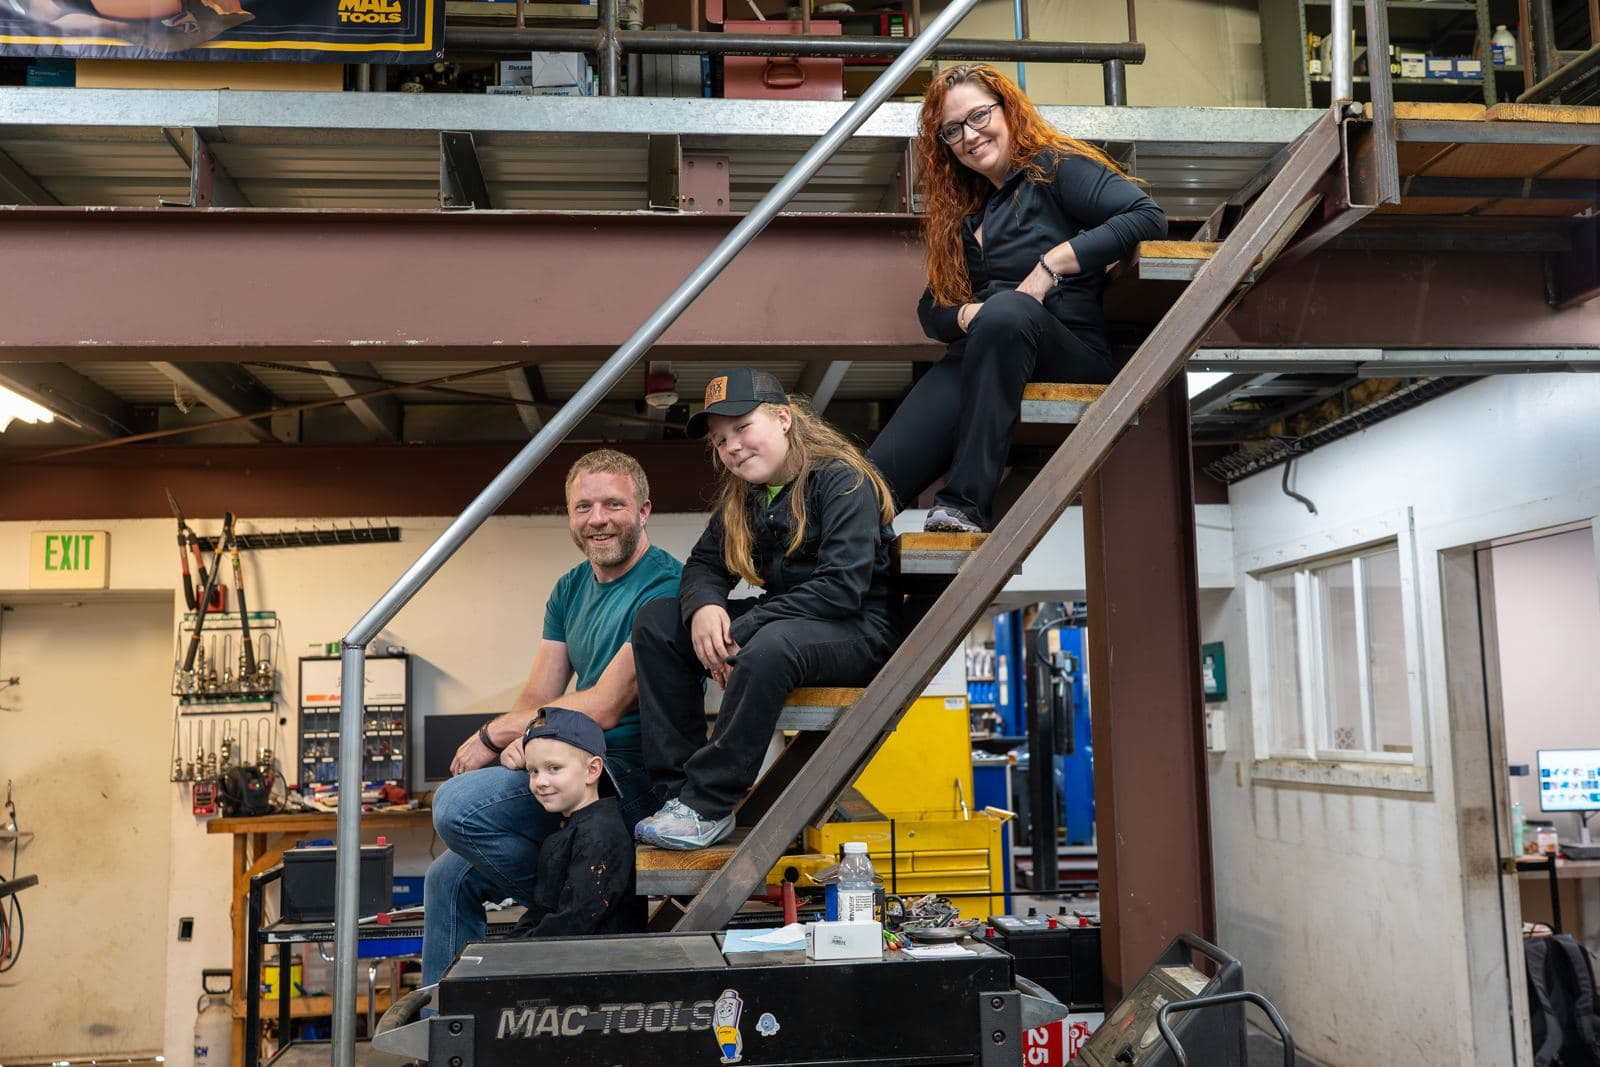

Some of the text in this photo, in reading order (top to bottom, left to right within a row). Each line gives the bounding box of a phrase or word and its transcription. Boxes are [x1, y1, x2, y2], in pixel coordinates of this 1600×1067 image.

[338, 12, 401, 23] TOOLS
[45, 535, 94, 570] EXIT
[496, 1000, 715, 1039] MAC TOOLS
[1028, 1027, 1049, 1065] 25
